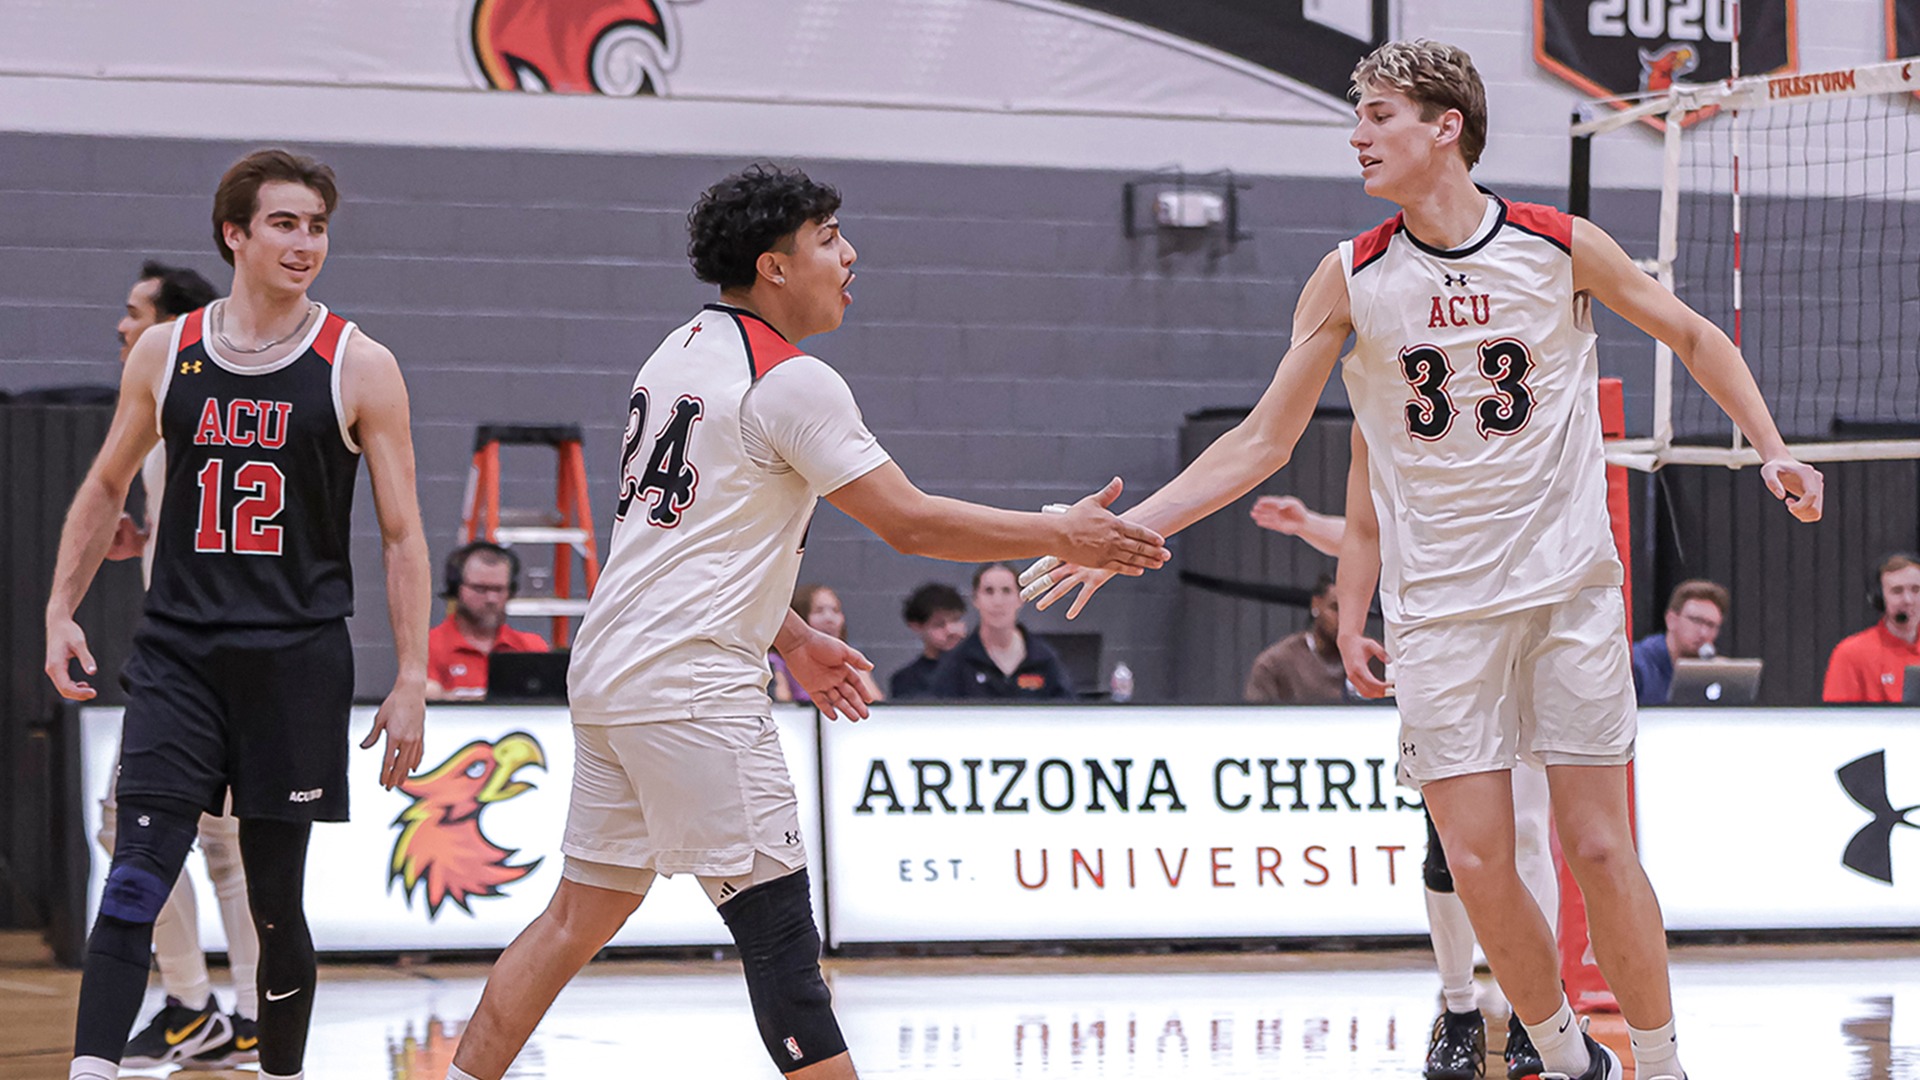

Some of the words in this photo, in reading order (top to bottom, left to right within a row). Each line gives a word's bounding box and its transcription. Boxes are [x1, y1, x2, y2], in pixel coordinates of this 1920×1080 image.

[1587, 0, 1741, 42] 2020
[1768, 69, 1855, 99] FIRESTORM
[1428, 294, 1490, 328] ACU
[1398, 337, 1538, 442] 33
[193, 397, 292, 449] ACU
[195, 458, 286, 556] 12
[854, 758, 1187, 813] ARIZONA
[899, 858, 976, 882] EST.
